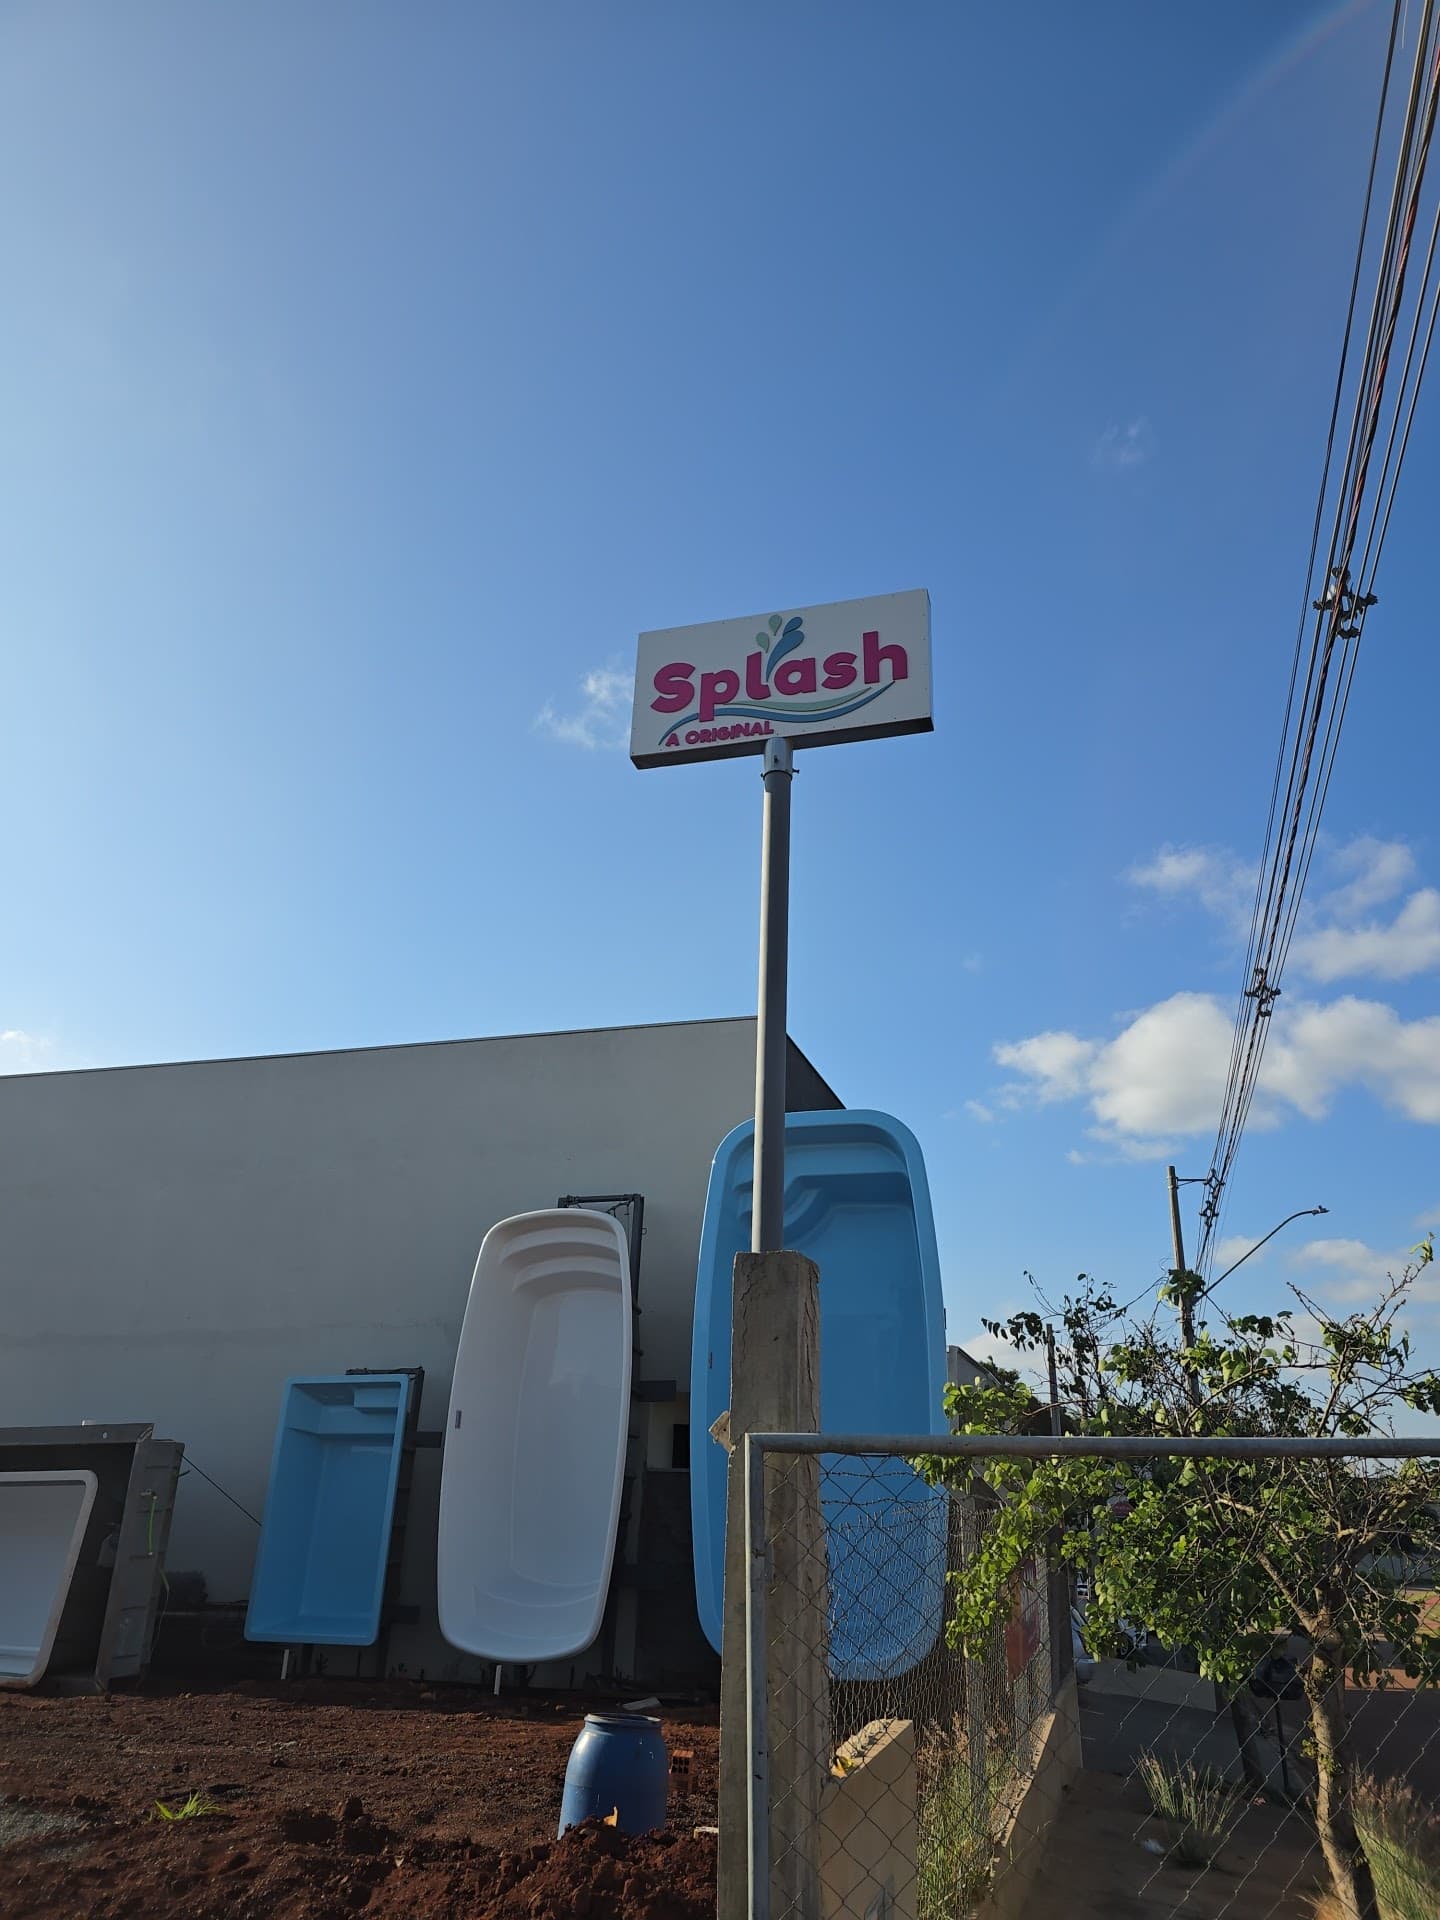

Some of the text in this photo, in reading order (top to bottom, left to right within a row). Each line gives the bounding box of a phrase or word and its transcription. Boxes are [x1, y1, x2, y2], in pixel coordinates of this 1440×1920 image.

[650, 631, 908, 722] Splash
[665, 720, 774, 747] A ORIGINAL
